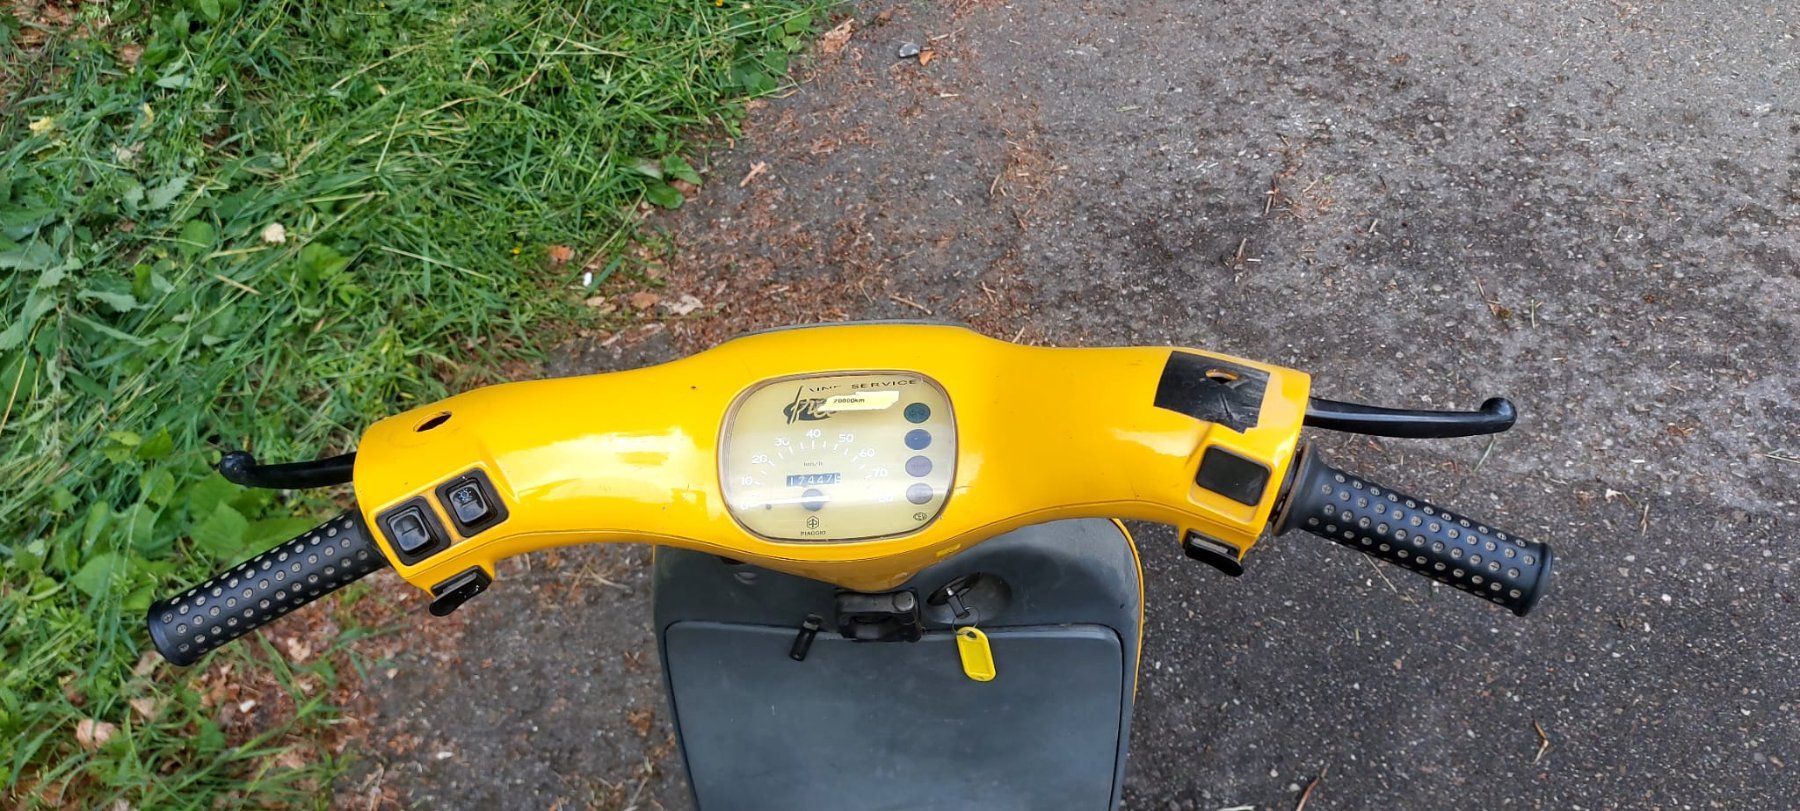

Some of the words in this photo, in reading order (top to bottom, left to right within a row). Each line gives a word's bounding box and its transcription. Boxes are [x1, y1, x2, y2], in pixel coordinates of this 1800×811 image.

[851, 379, 917, 390] SERVICE
[805, 428, 822, 439] 40
[838, 433, 855, 443] 50
[774, 436, 790, 447] 30
[858, 447, 875, 458] 60
[751, 454, 768, 464] 20
[872, 467, 888, 478] 70
[741, 476, 753, 486] 10
